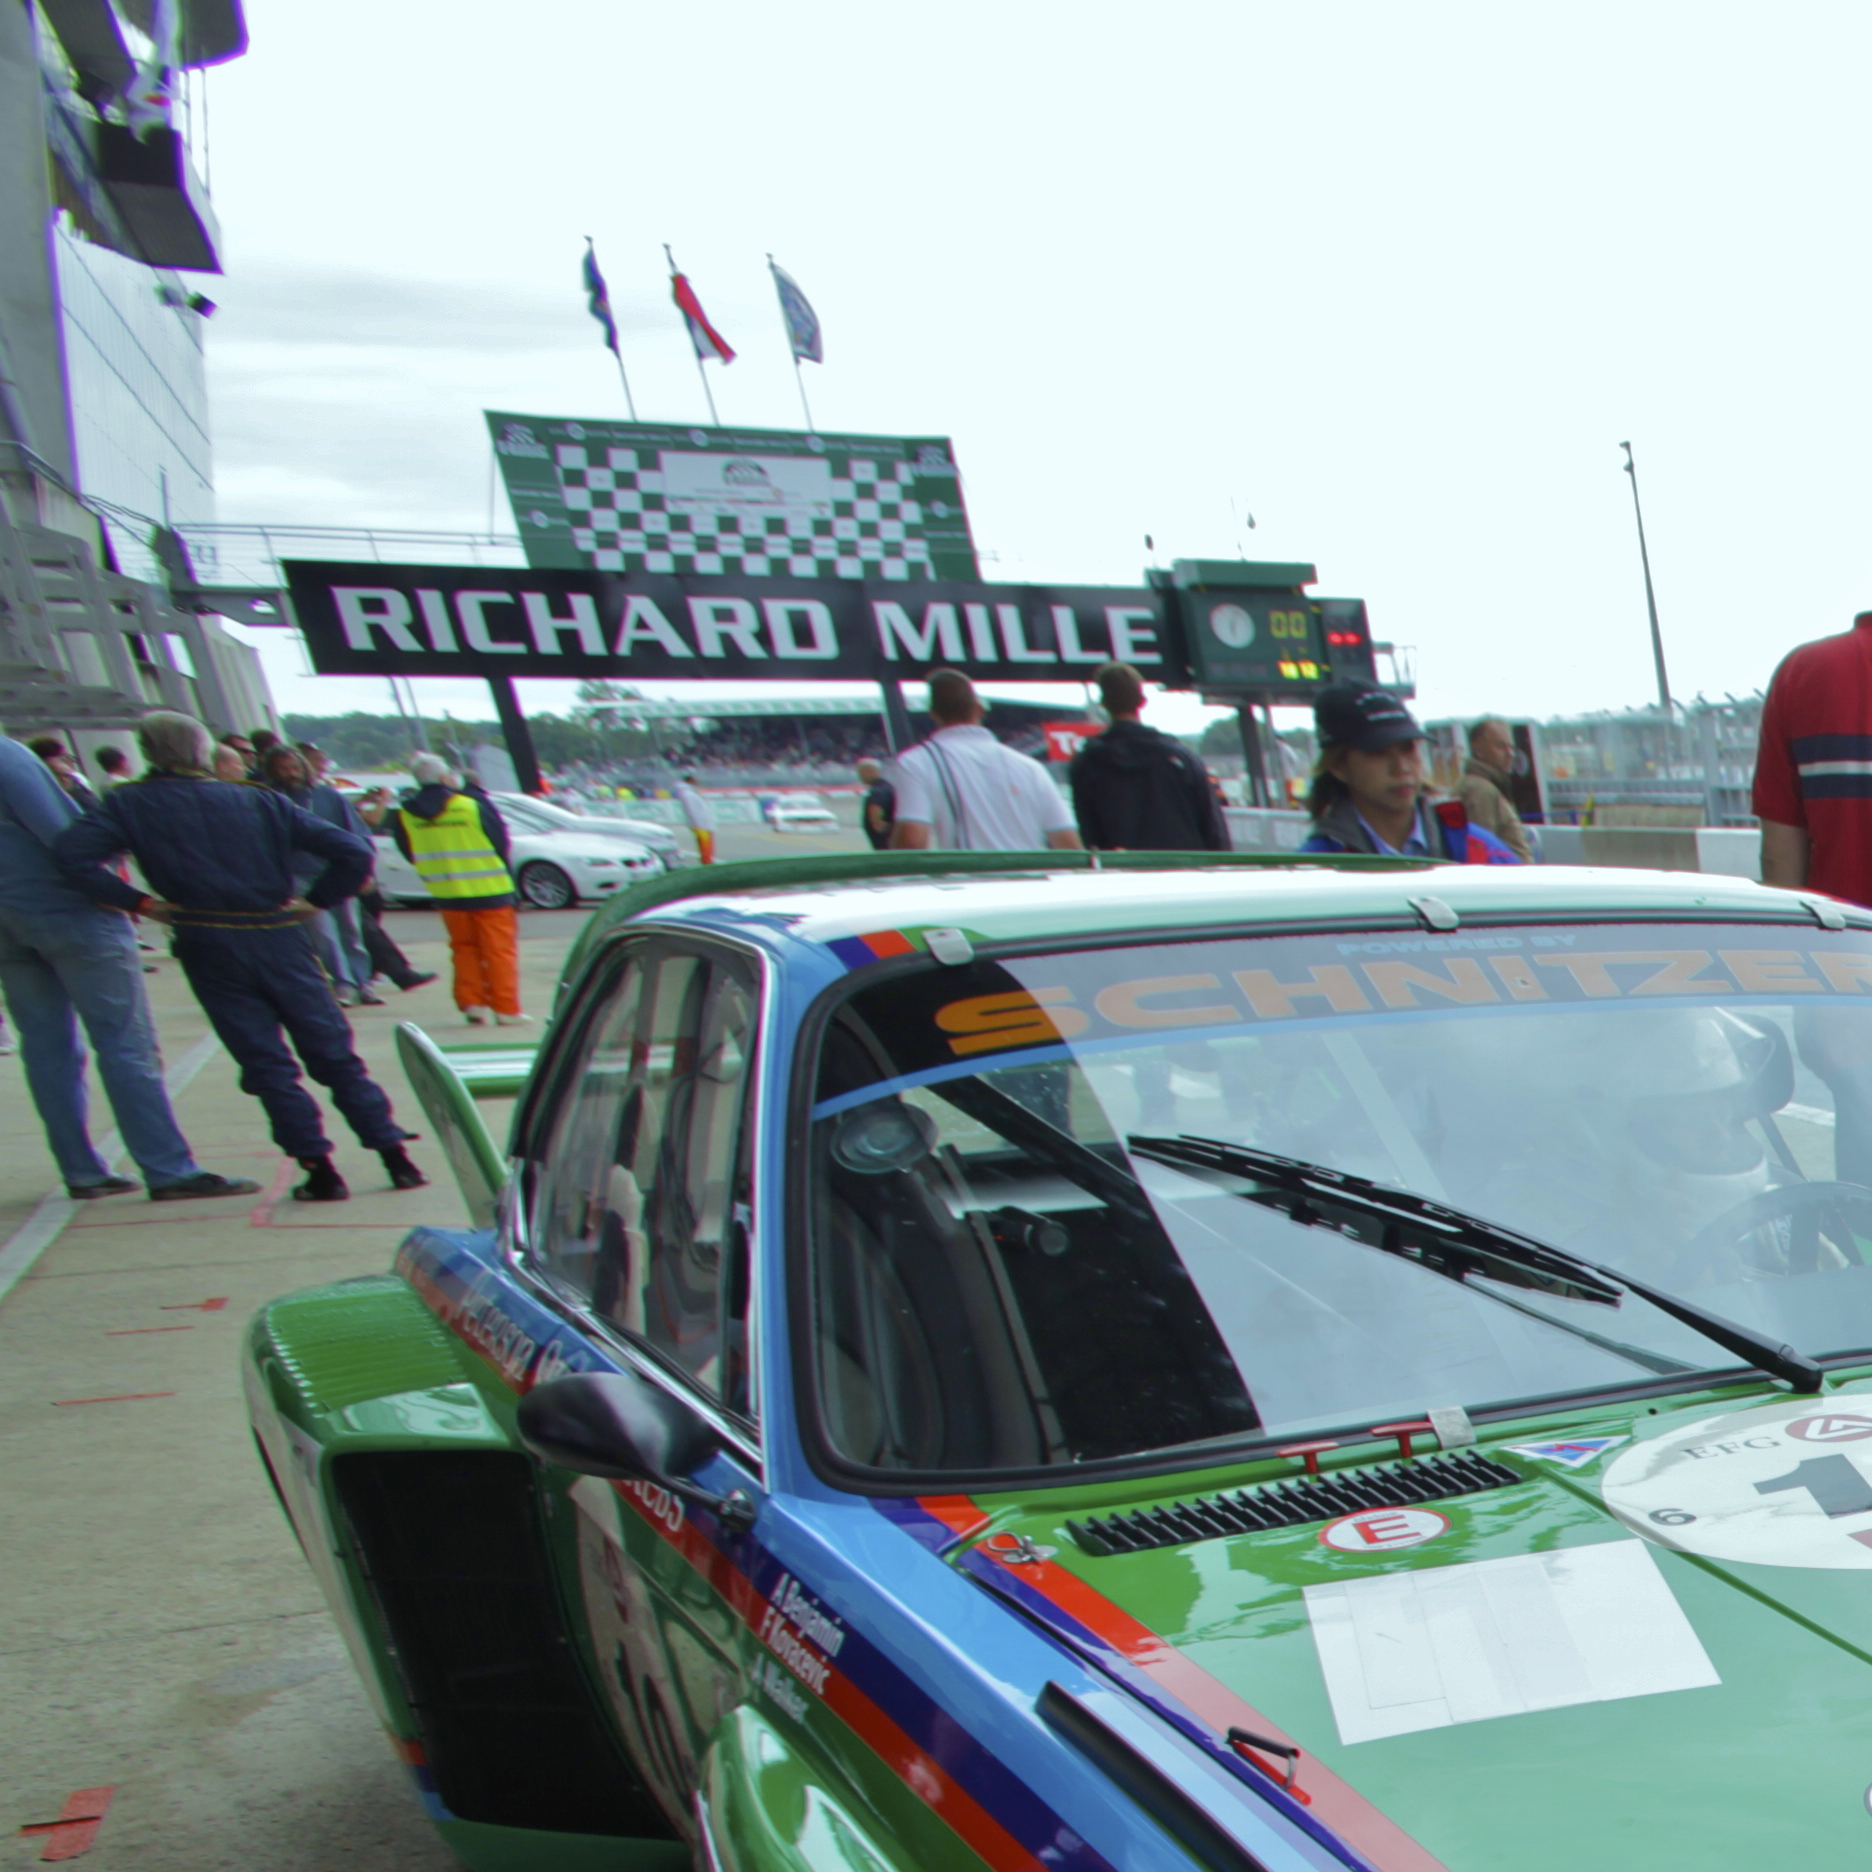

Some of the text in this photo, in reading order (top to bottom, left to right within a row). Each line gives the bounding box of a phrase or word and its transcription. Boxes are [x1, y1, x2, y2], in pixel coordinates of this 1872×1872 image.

[330, 586, 1163, 664] RICHARD MILLE
[1336, 935, 1576, 956] POWERED BY
[1683, 1436, 1782, 1459] EFG
[1650, 1507, 1697, 1526] 6
[781, 1580, 845, 1657] Benjamin
